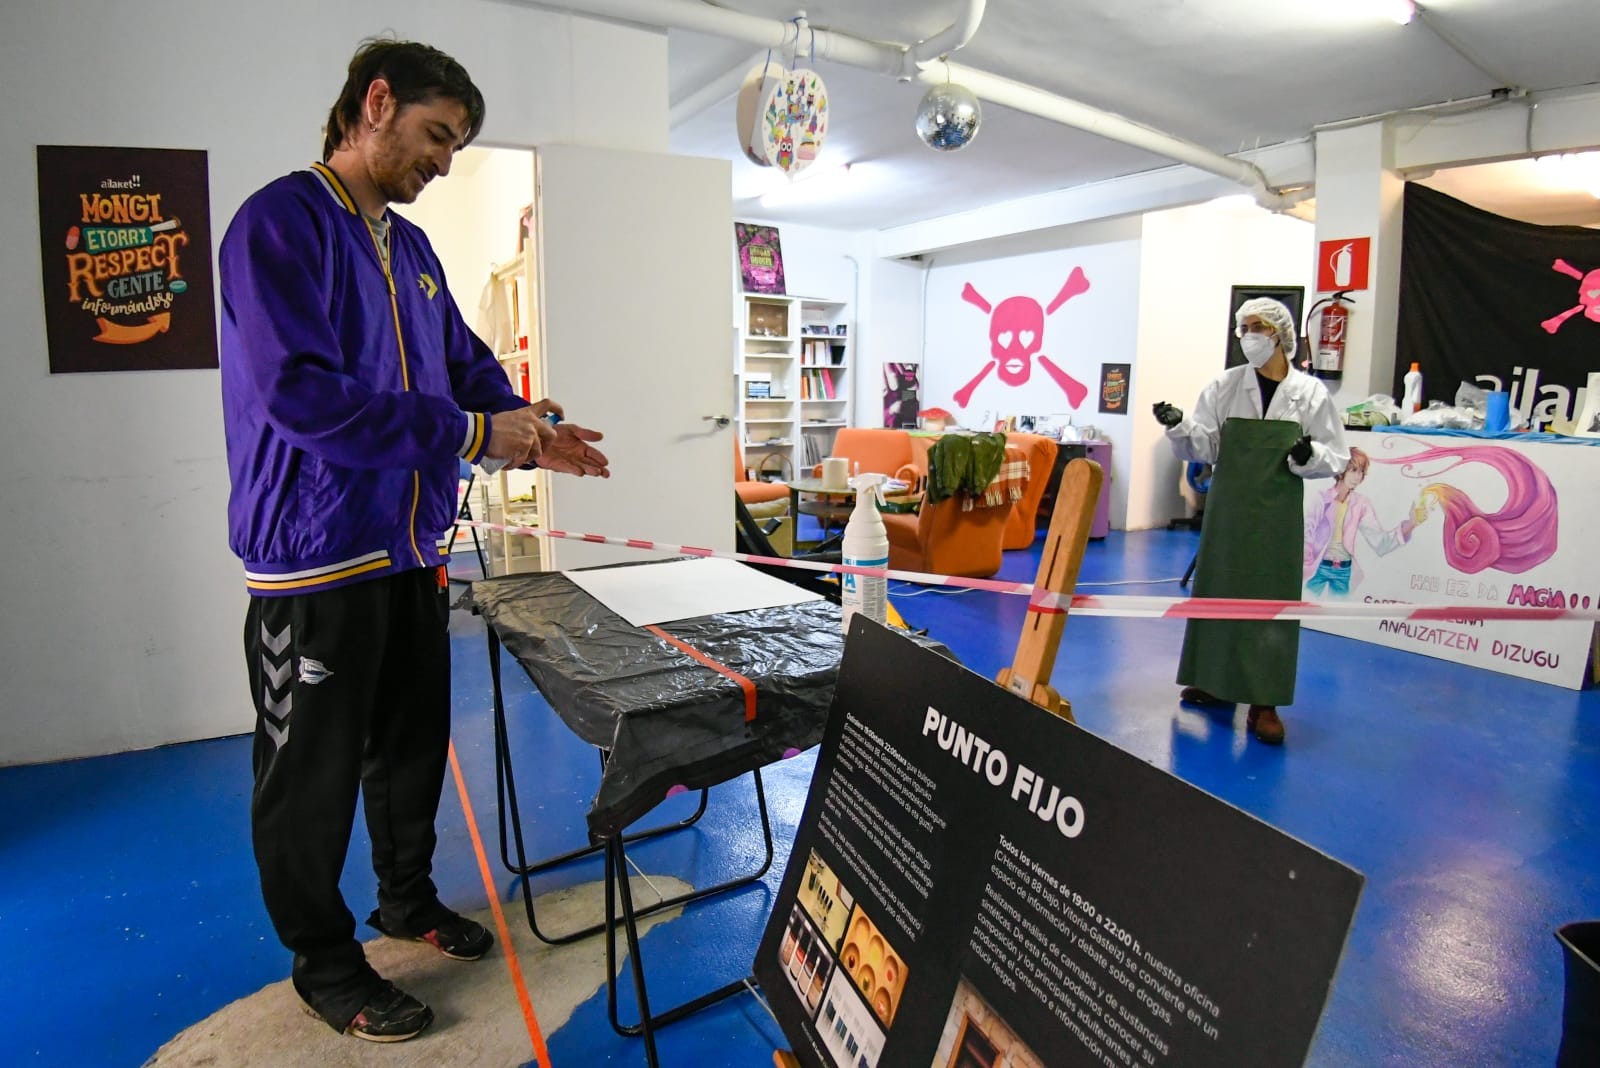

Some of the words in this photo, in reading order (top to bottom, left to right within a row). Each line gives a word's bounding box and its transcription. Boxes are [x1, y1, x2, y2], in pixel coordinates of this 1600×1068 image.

[87, 231, 147, 250] ETORRI
[107, 271, 164, 299] GENTE
[1379, 619, 1479, 651] ANALIZATZEN
[1491, 640, 1560, 669] DIZUGU
[922, 706, 1008, 785] PUNTO
[1011, 764, 1085, 838] FIJO
[973, 925, 1007, 963] producirse
[1007, 958, 1014, 970] el
[1015, 966, 1048, 1003] consumo
[1048, 999, 1054, 1009] e
[1055, 1004, 1103, 1059] información
[985, 883, 1022, 921] Realizamos
[1049, 941, 1060, 956] de
[1060, 950, 1097, 990] cannabis
[1097, 986, 1104, 999] y
[1105, 991, 1118, 1009] de
[1119, 1003, 1169, 1056] sustancias
[991, 863, 1016, 890] espacio
[1017, 886, 1026, 898] de
[1027, 893, 1070, 935] información
[1070, 933, 1076, 944] y
[1078, 936, 1108, 968] debate
[1109, 962, 1135, 992] sobre
[1136, 986, 1174, 1028] drogas.
[999, 834, 1019, 856] Todos
[1019, 851, 1031, 865] los
[1031, 860, 1059, 888] viernes
[1060, 883, 1071, 898] de
[1071, 892, 1096, 918] 19:00
[1096, 914, 1102, 923] a
[1104, 917, 1132, 946] 22:00
[1133, 941, 1143, 955] h.
[1144, 951, 1181, 987] nuestra
[1183, 981, 1220, 1018] oficina
[1031, 878, 1042, 892] 88
[1126, 958, 1137, 972] se
[1139, 967, 1185, 1012] convierte
[1187, 1008, 1201, 1026] en
[1203, 1021, 1218, 1041] un
[1013, 926, 1024, 942] De
[1024, 938, 1040, 957] esta
[1041, 952, 1064, 979] forma
[1063, 973, 1103, 1018] podemos
[1103, 1012, 1141, 1053] conocer
[1142, 1048, 1155, 1066] su
[1017, 951, 1023, 962] y
[1023, 955, 1035, 971] los
[1035, 966, 1077, 1013] principales
[1077, 1006, 1131, 1065] adulterantes
